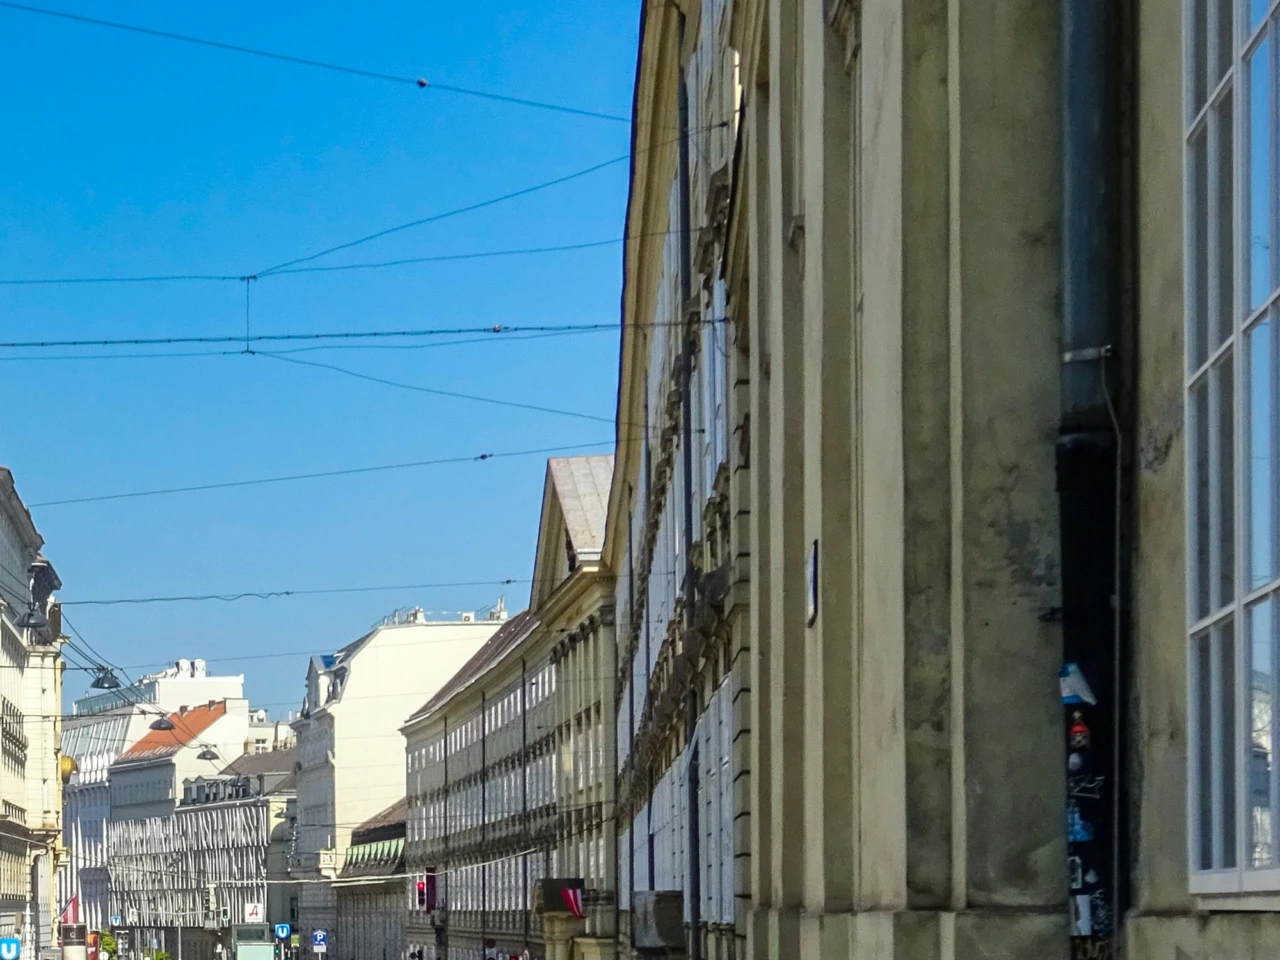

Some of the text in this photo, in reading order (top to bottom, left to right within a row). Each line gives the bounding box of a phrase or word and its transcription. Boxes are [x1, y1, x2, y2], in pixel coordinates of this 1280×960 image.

[277, 927, 287, 938] U
[317, 933, 324, 942] P
[1, 943, 17, 959] U
